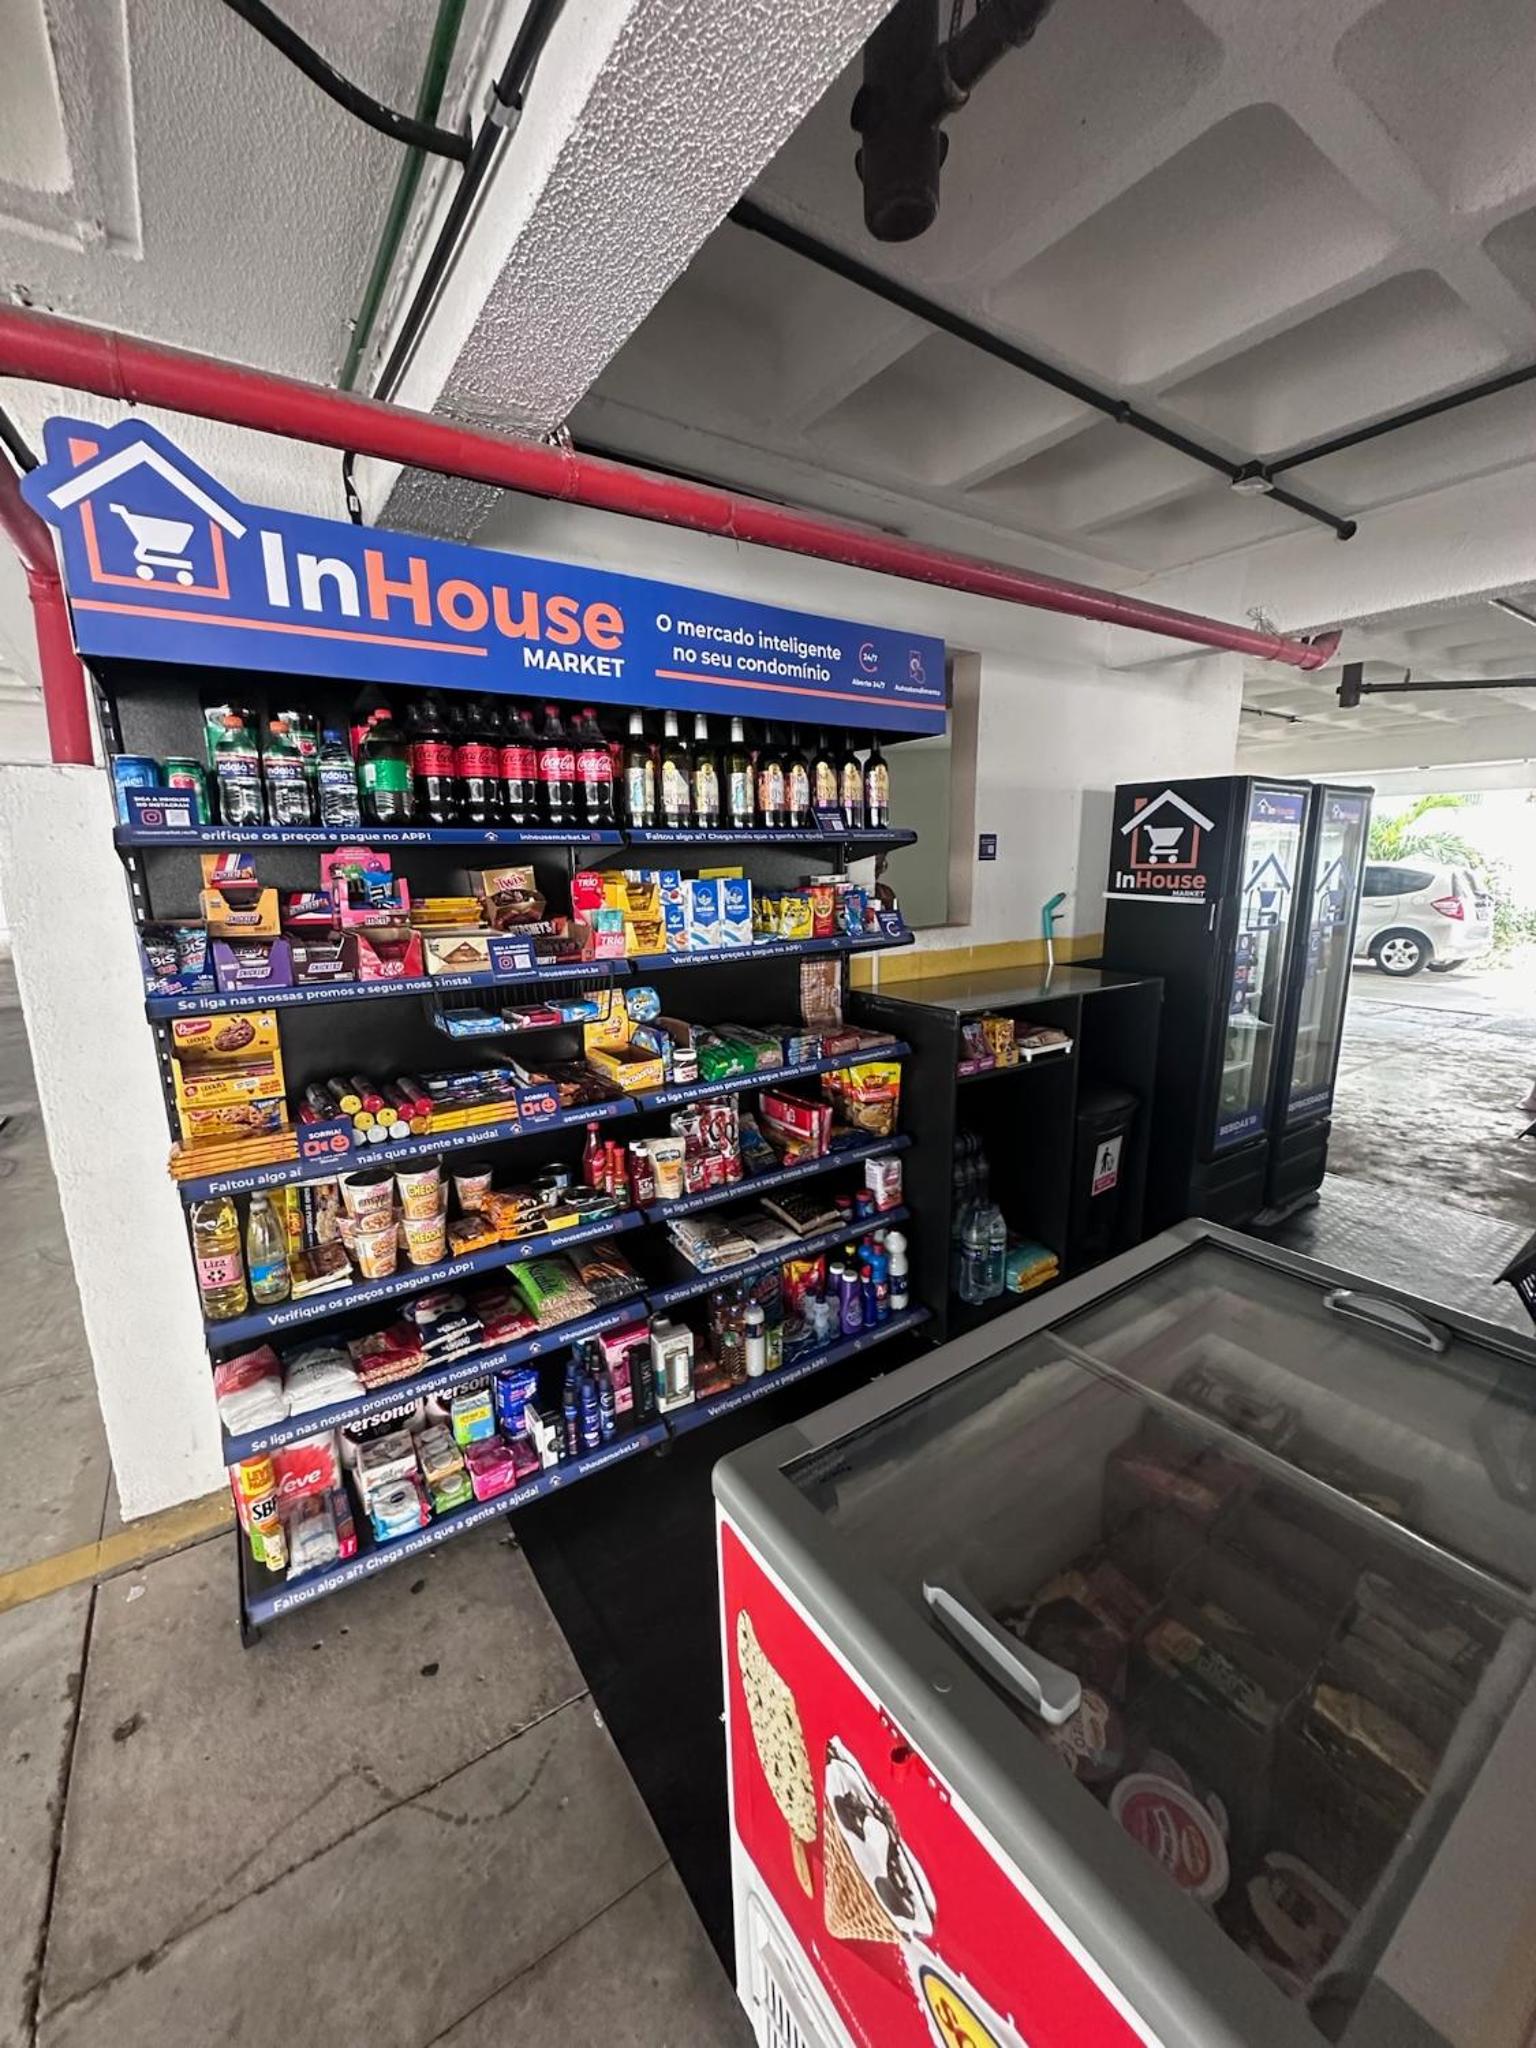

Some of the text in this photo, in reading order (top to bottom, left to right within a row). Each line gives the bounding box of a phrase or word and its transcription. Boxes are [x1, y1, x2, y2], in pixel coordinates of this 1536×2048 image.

[260, 530, 625, 651] InHouse
[656, 614, 841, 661] O mercado inteligente
[523, 647, 625, 679] MARKET
[673, 645, 831, 682] no seu condomínio
[202, 828, 259, 845] erifique
[262, 832, 279, 841] os
[282, 832, 326, 845] preços
[329, 832, 338, 841] e
[341, 832, 380, 845] pague
[383, 832, 399, 841] no
[402, 831, 432, 841] APP!
[1116, 870, 1207, 890] InHouse
[1172, 889, 1205, 898] MARKET
[539, 967, 599, 978] housemarket.br
[178, 976, 472, 1011] Se liga nas nossas promos e segue noss insta!
[667, 1091, 685, 1105] liga
[699, 1083, 724, 1095] nossas
[725, 1077, 752, 1092] promos
[209, 1176, 254, 1194] Faltou
[258, 1171, 287, 1185] algo
[385, 1149, 407, 1162] que
[409, 1146, 417, 1154] a
[419, 1139, 451, 1155] gente
[454, 1135, 465, 1146] te
[467, 1130, 499, 1145] ajuda!
[267, 1261, 475, 1327] Verifique os preços e pague no APP!
[251, 1354, 508, 1452] Se liga nas nossas promos e segue nosso insta!
[273, 1484, 539, 1613] Faltou algo aí? Chega mais que a gente te ajuda!
